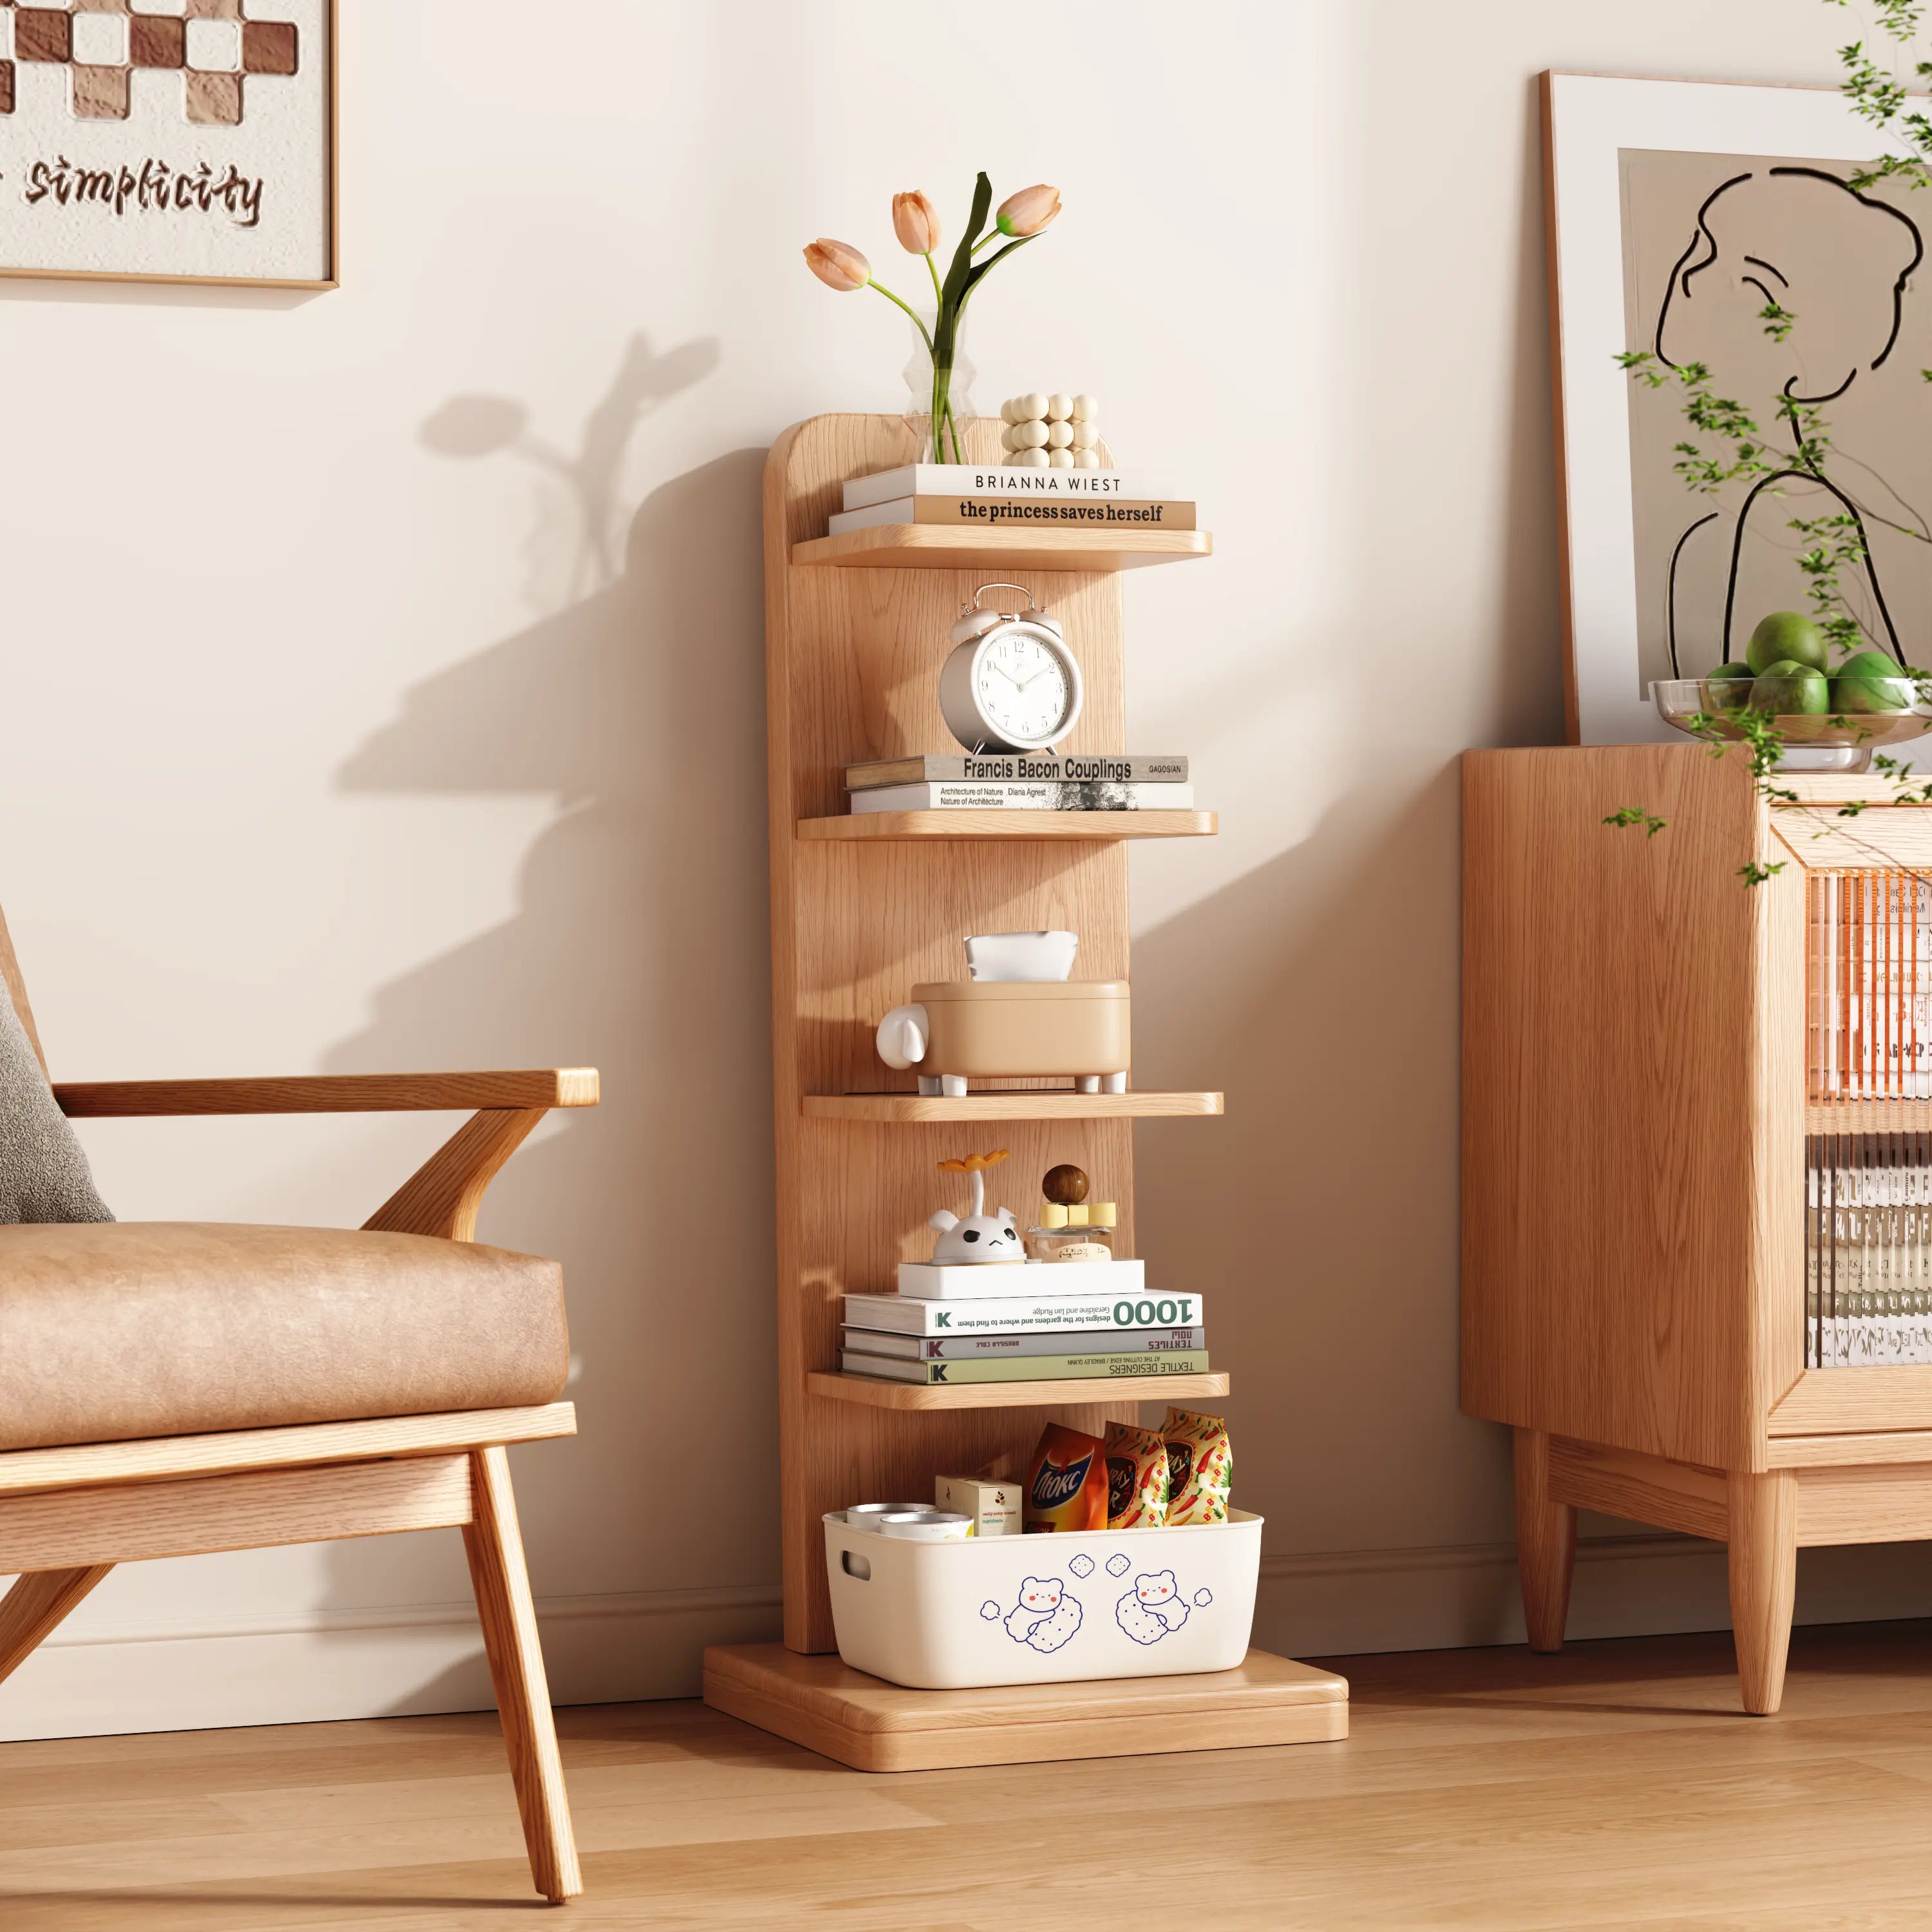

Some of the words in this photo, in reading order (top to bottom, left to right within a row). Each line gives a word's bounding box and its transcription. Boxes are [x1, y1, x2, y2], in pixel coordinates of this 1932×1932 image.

[976, 475, 1058, 489] BRIANNA
[1068, 478, 1120, 491] WIEST
[960, 500, 987, 517] the
[989, 501, 1058, 522] princess
[1060, 507, 1104, 520] saves
[1106, 504, 1163, 522] herself
[999, 646, 1007, 658] 11
[1013, 641, 1025, 653] 12
[987, 659, 996, 672] 10
[1048, 662, 1056, 674] 2
[981, 679, 989, 691] 9
[1056, 682, 1063, 694] 3
[989, 700, 996, 712] 8
[1052, 703, 1057, 714] 4
[1003, 715, 1010, 726] 7
[1041, 716, 1048, 728] 5
[1022, 721, 1029, 733] 6
[963, 758, 1013, 778] Francis
[1018, 759, 1060, 778] Bacon
[1065, 758, 1132, 781] Couplings
[1149, 765, 1181, 773] GAGOSIAN
[1008, 788, 1025, 796] Diana
[1027, 788, 1046, 797] Agrest
[1113, 1299, 1193, 1326] 1000
[938, 1312, 952, 1327] K
[929, 1341, 944, 1358] K
[1148, 1340, 1192, 1349] TEXTILES
[933, 1365, 948, 1381] K
[1109, 1365, 1157, 1374] DESIGNERS
[1160, 1362, 1194, 1372] TEXTILE
